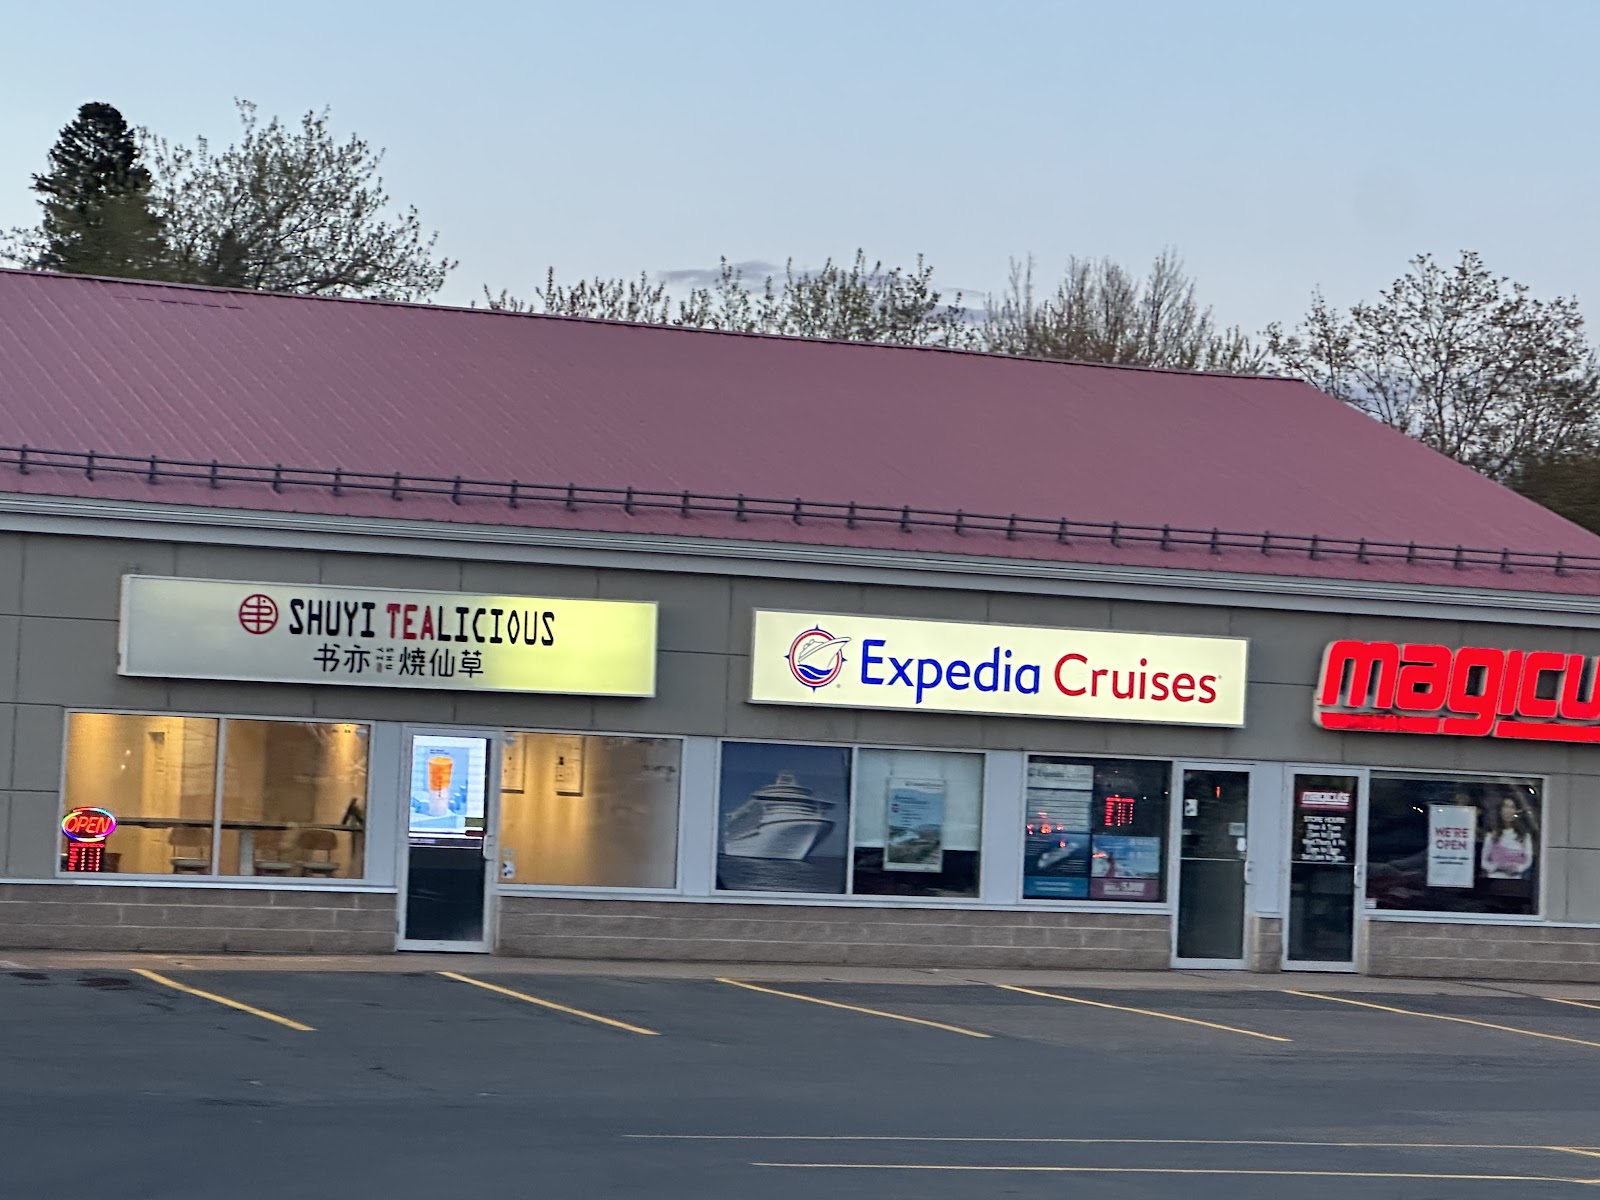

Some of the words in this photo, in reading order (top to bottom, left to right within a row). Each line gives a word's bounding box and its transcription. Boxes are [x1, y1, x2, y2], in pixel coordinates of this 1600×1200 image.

[289, 598, 376, 638] SHUYI
[386, 603, 555, 646] TEALICIOUS
[861, 638, 1041, 704] Expedia
[1054, 653, 1217, 704] Cruises
[65, 815, 111, 834] OPEN
[1436, 839, 1467, 850] OPEN
